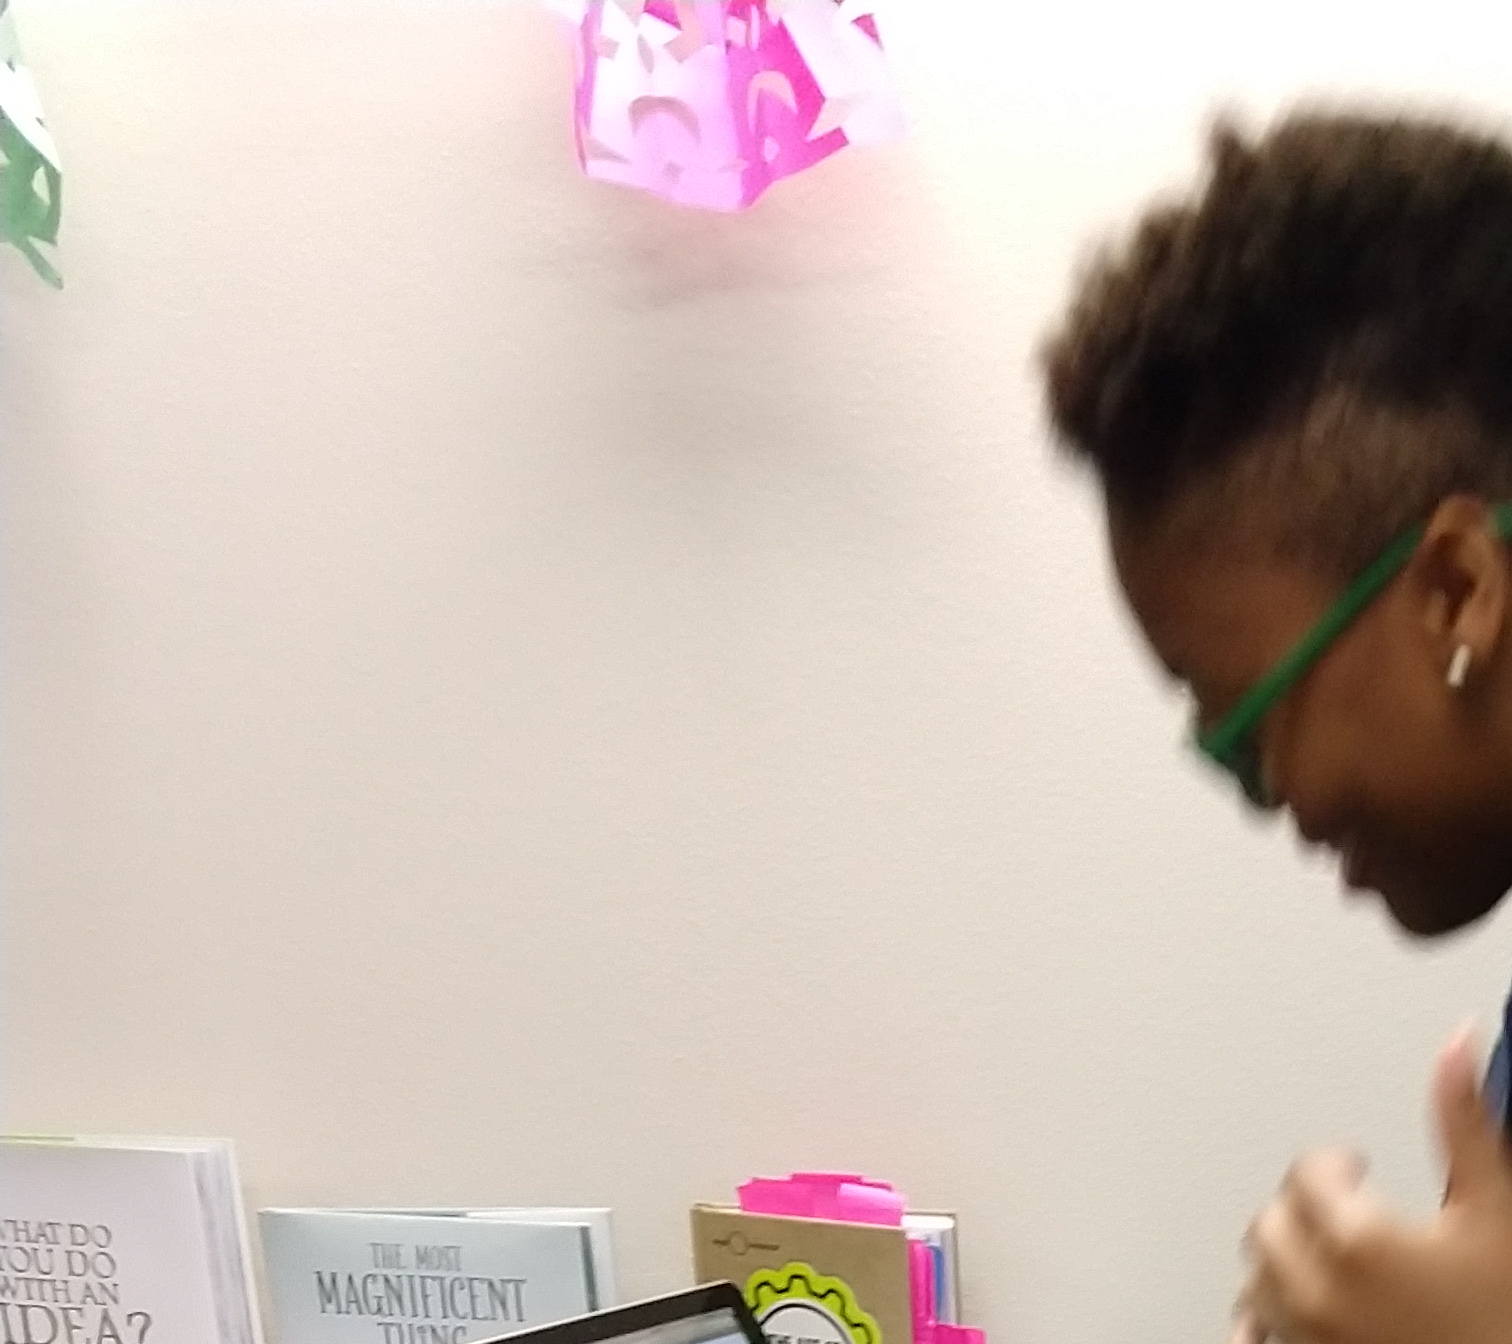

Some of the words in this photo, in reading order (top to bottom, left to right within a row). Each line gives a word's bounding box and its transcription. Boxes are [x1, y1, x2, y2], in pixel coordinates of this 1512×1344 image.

[0, 1219, 62, 1245] HAT
[67, 1223, 112, 1249] DO
[65, 1250, 117, 1278] DO
[368, 1242, 407, 1269] THE
[415, 1245, 462, 1271] MOST
[0, 1275, 72, 1304] WITH
[81, 1282, 119, 1306] AN
[313, 1270, 528, 1322] MAGNIFICENT
